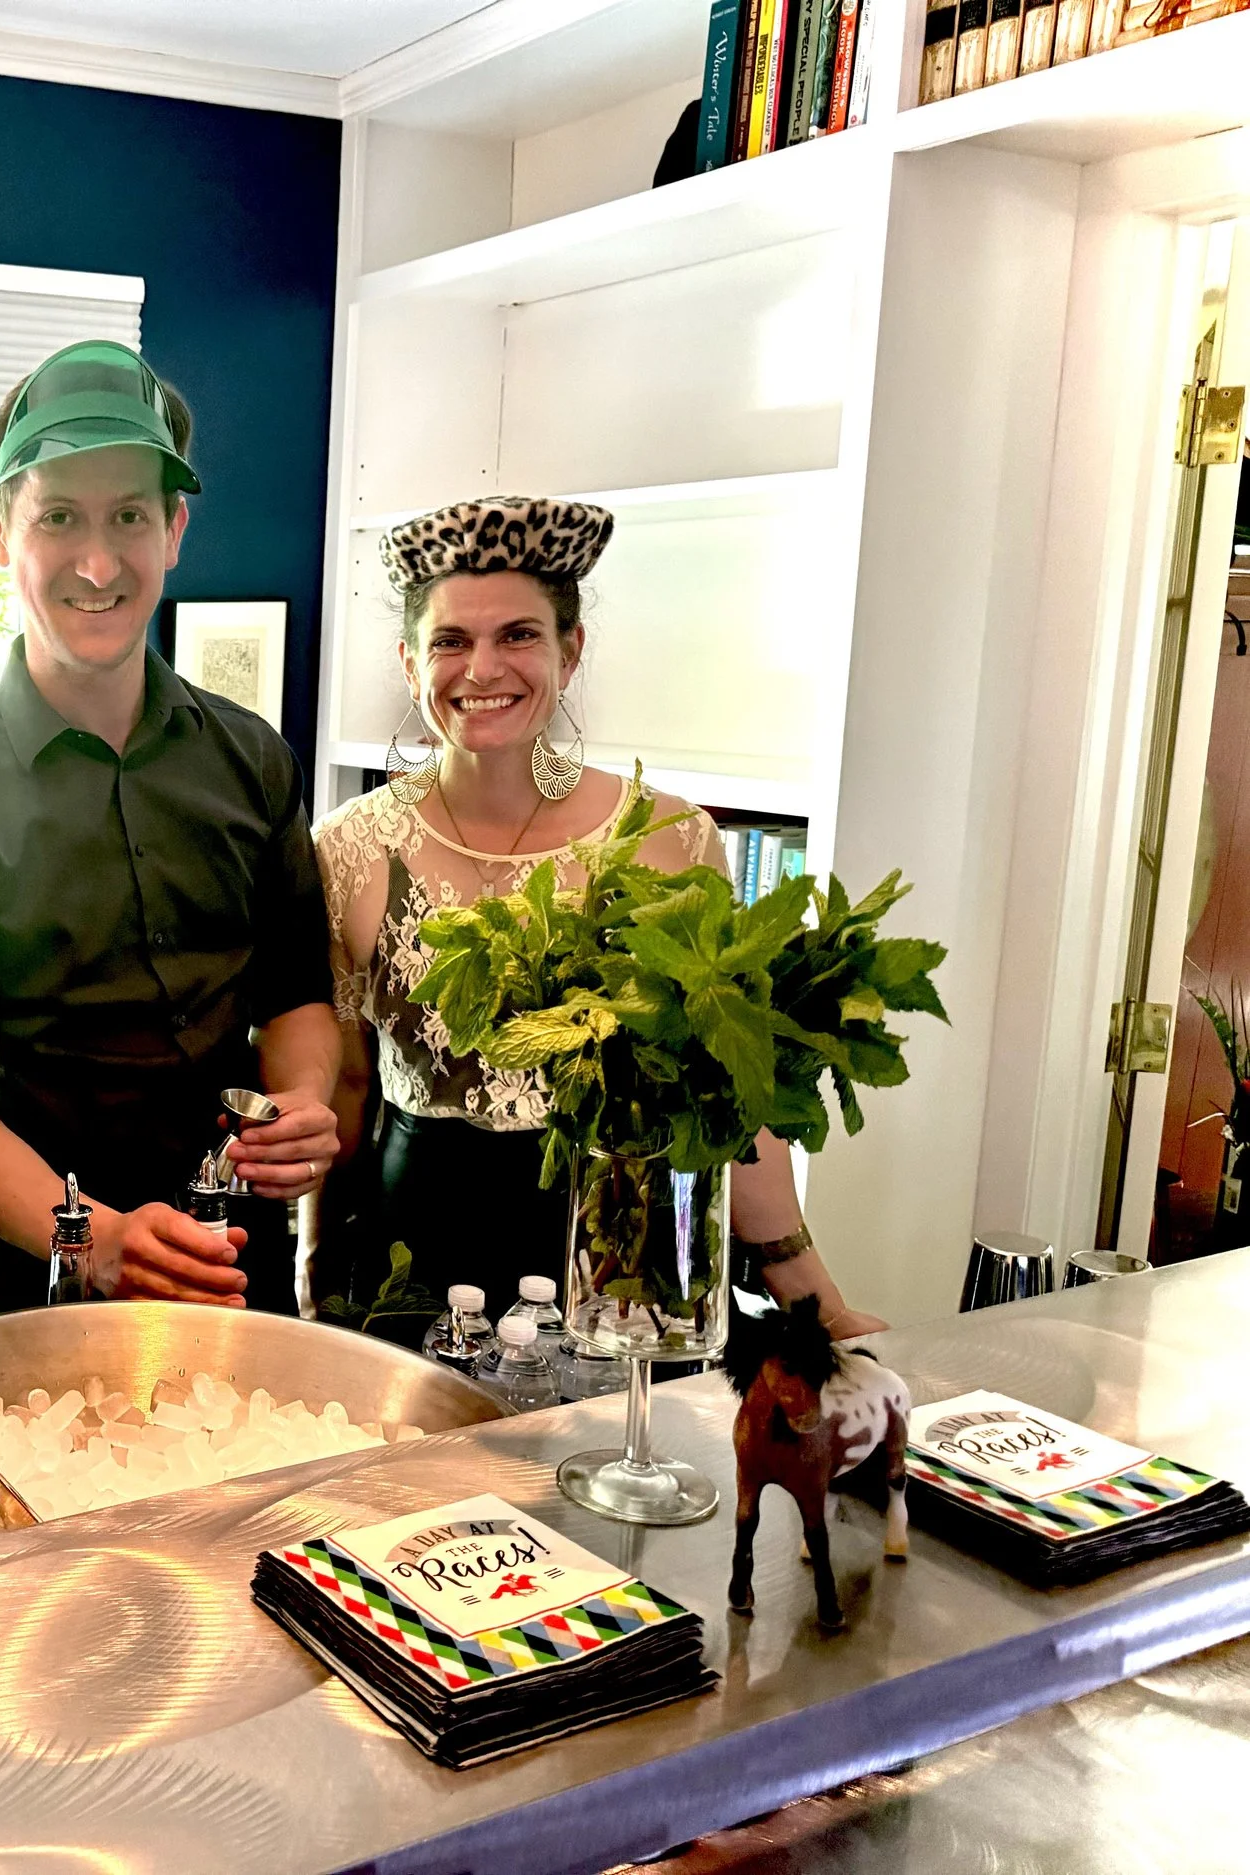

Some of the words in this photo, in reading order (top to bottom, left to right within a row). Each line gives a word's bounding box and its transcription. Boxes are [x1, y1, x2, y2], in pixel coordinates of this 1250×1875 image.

[798, 17, 811, 78] SPECIAL
[839, 20, 848, 55] BOOK
[710, 31, 728, 102] Winter's
[792, 80, 804, 136] PEOPLE
[830, 72, 842, 130] ENDINGS
[706, 108, 721, 141] Tale
[932, 1430, 953, 1438] A
[939, 1413, 975, 1428] DAY
[974, 1428, 1004, 1438] THE
[981, 1412, 1006, 1423] AT
[937, 1416, 1066, 1464] Races!
[400, 1546, 422, 1559] A
[414, 1526, 458, 1547] DAY
[469, 1521, 494, 1536] AT
[446, 1542, 483, 1557] THE
[391, 1527, 550, 1591] Races!
